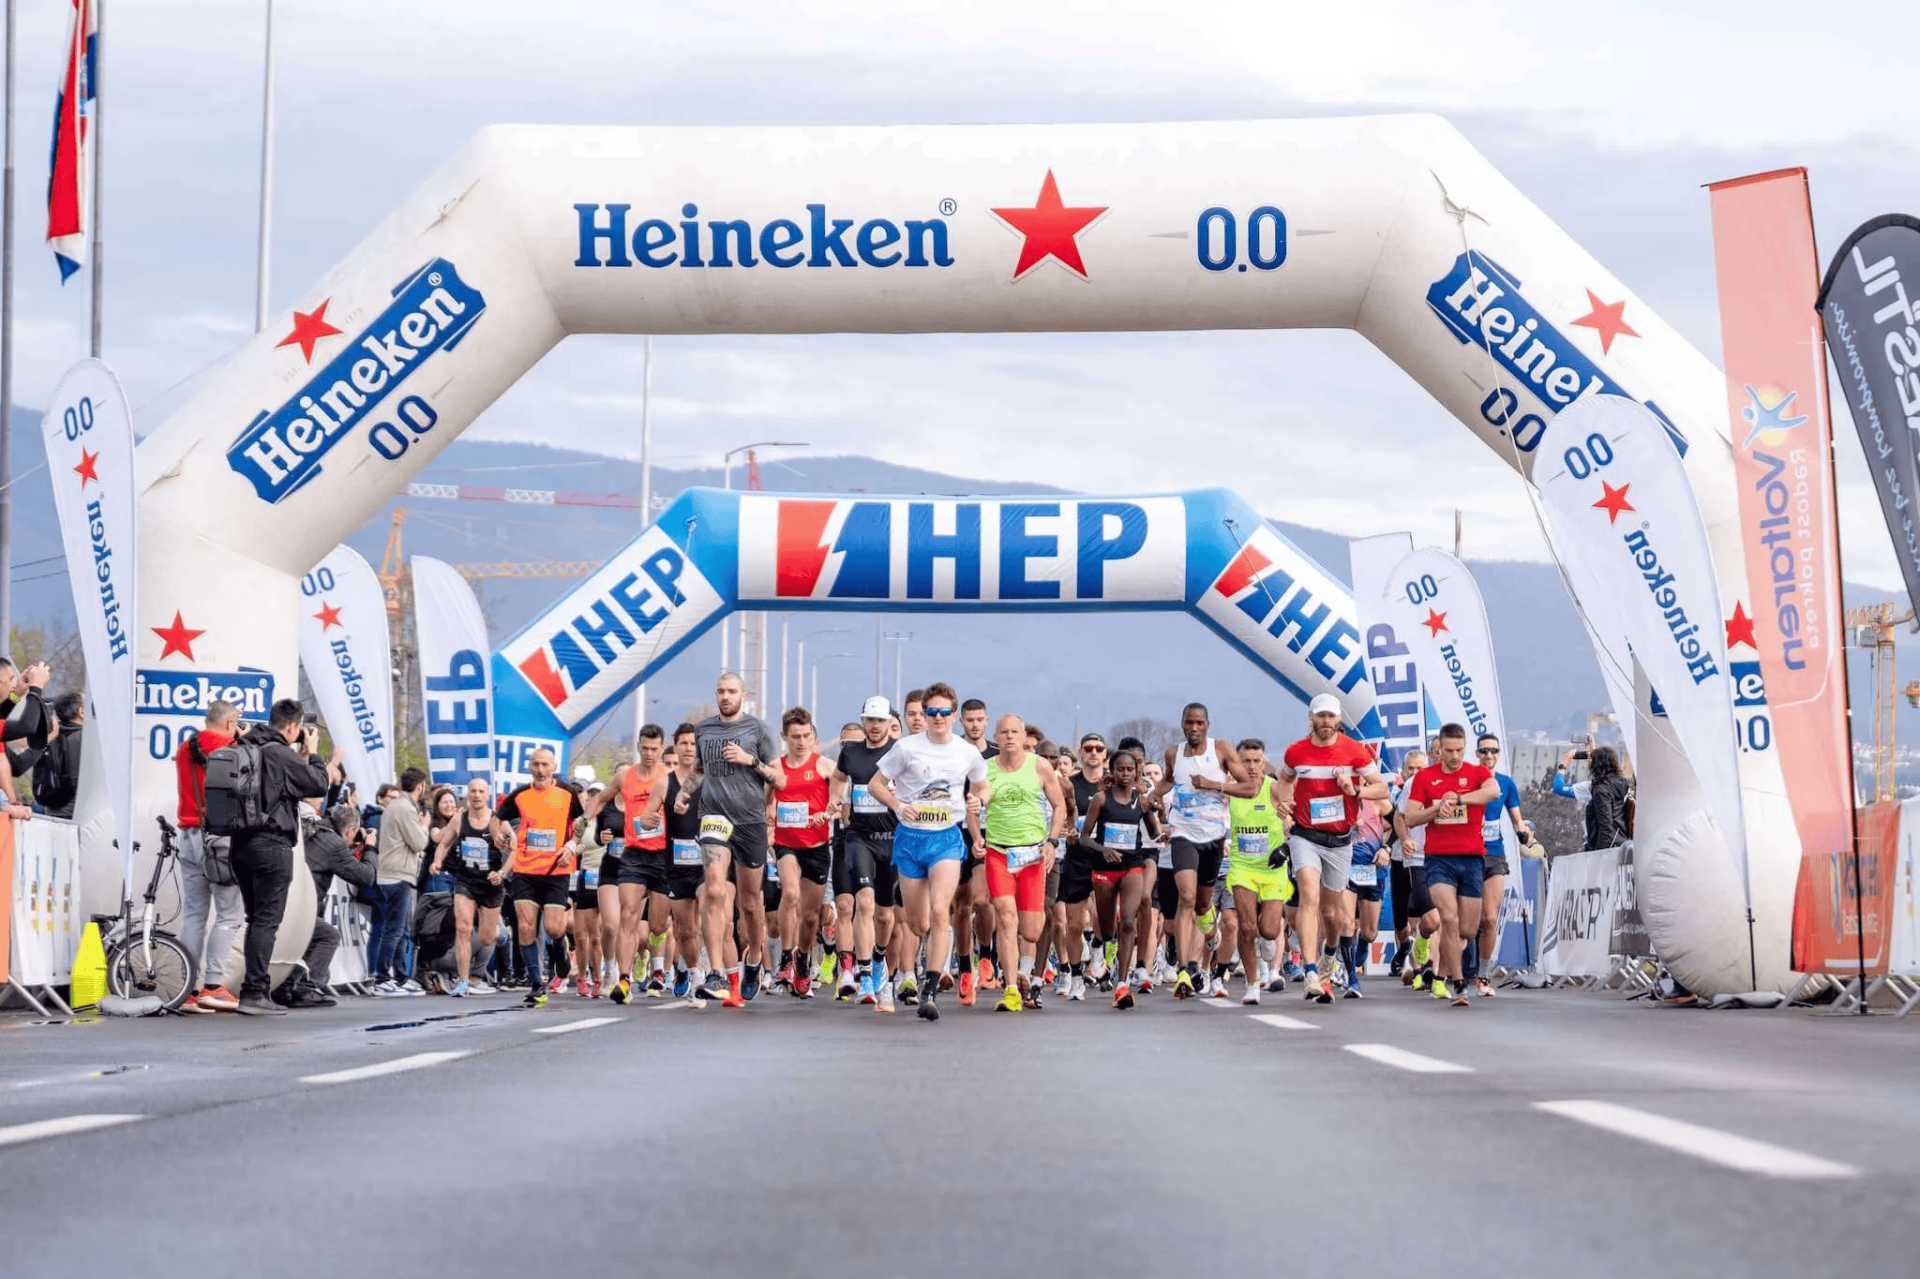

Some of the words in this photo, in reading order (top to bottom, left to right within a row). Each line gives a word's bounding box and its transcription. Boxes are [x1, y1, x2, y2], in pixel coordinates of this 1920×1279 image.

[1197, 206, 1287, 272] 0.0
[368, 395, 438, 460] 0.0
[1480, 387, 1546, 452] 0.0
[907, 503, 1148, 600] HEP
[571, 547, 687, 665] HEP
[1367, 623, 1420, 739] HEP
